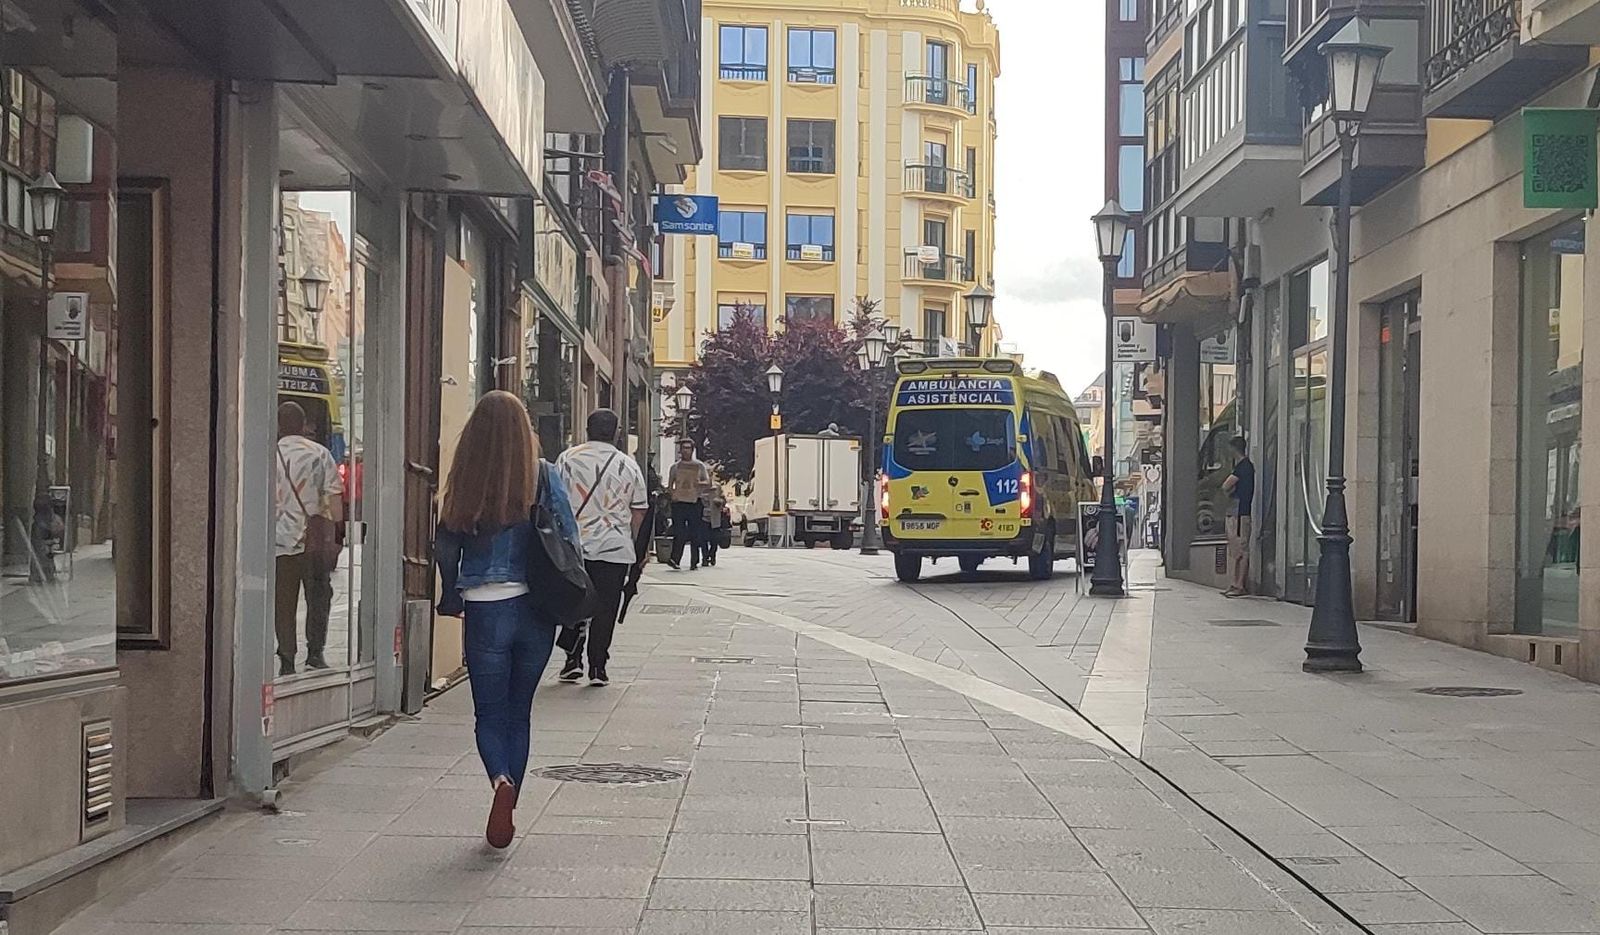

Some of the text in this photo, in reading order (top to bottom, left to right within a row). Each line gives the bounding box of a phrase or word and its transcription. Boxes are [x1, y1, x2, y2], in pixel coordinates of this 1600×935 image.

[661, 220, 714, 231] Samsonite
[907, 379, 1002, 391] AMBULANCIA
[907, 393, 1002, 404] ASISTENCIAL
[996, 479, 1018, 494] 112
